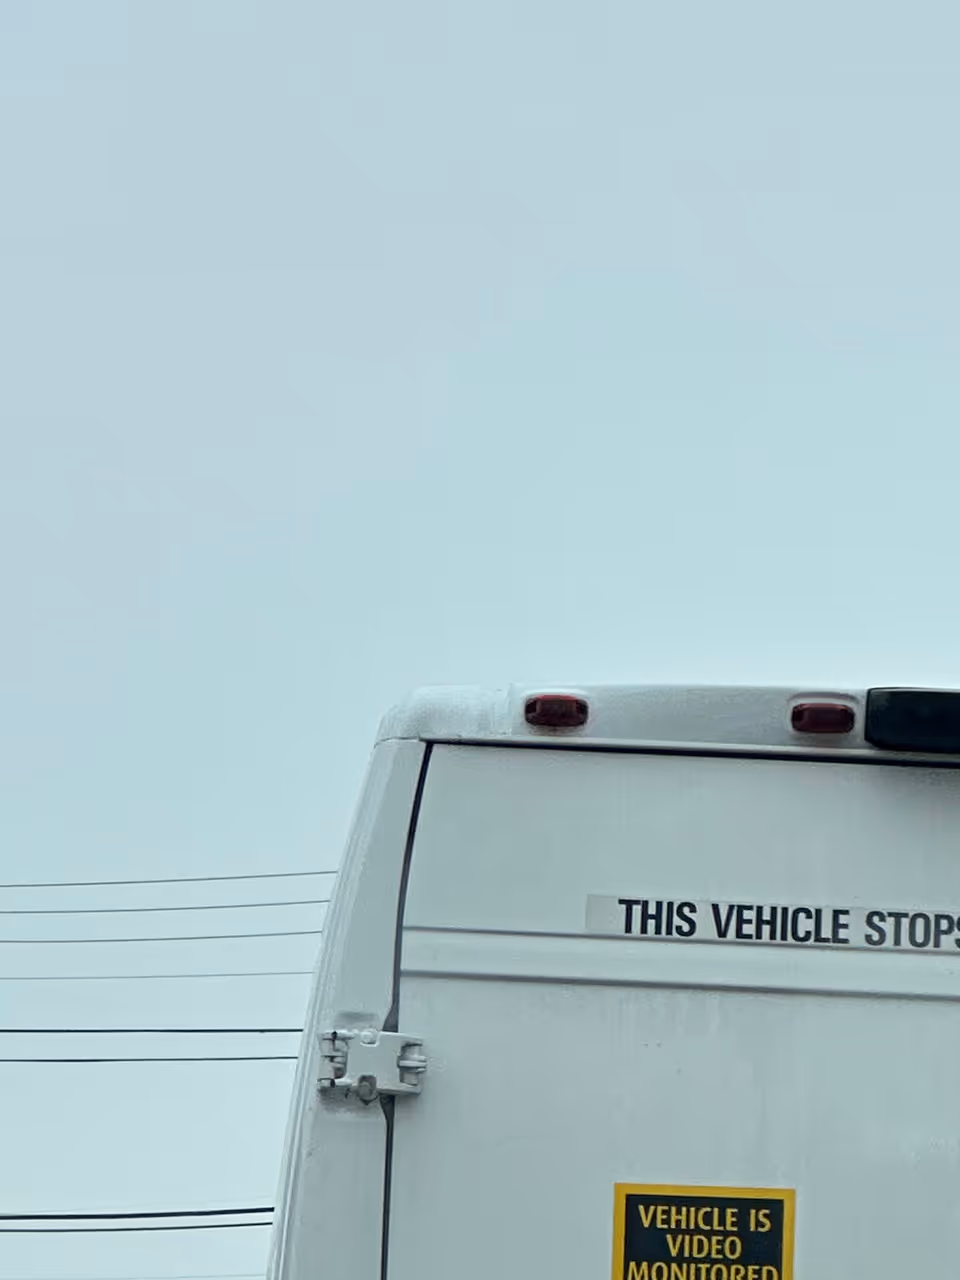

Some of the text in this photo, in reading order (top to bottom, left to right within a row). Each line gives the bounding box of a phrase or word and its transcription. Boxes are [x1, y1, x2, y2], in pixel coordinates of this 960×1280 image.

[618, 898, 698, 938] THIS
[711, 903, 850, 944] VEHICLE
[638, 1204, 772, 1232] VEHICLE IS
[666, 1234, 742, 1260] VIDEO
